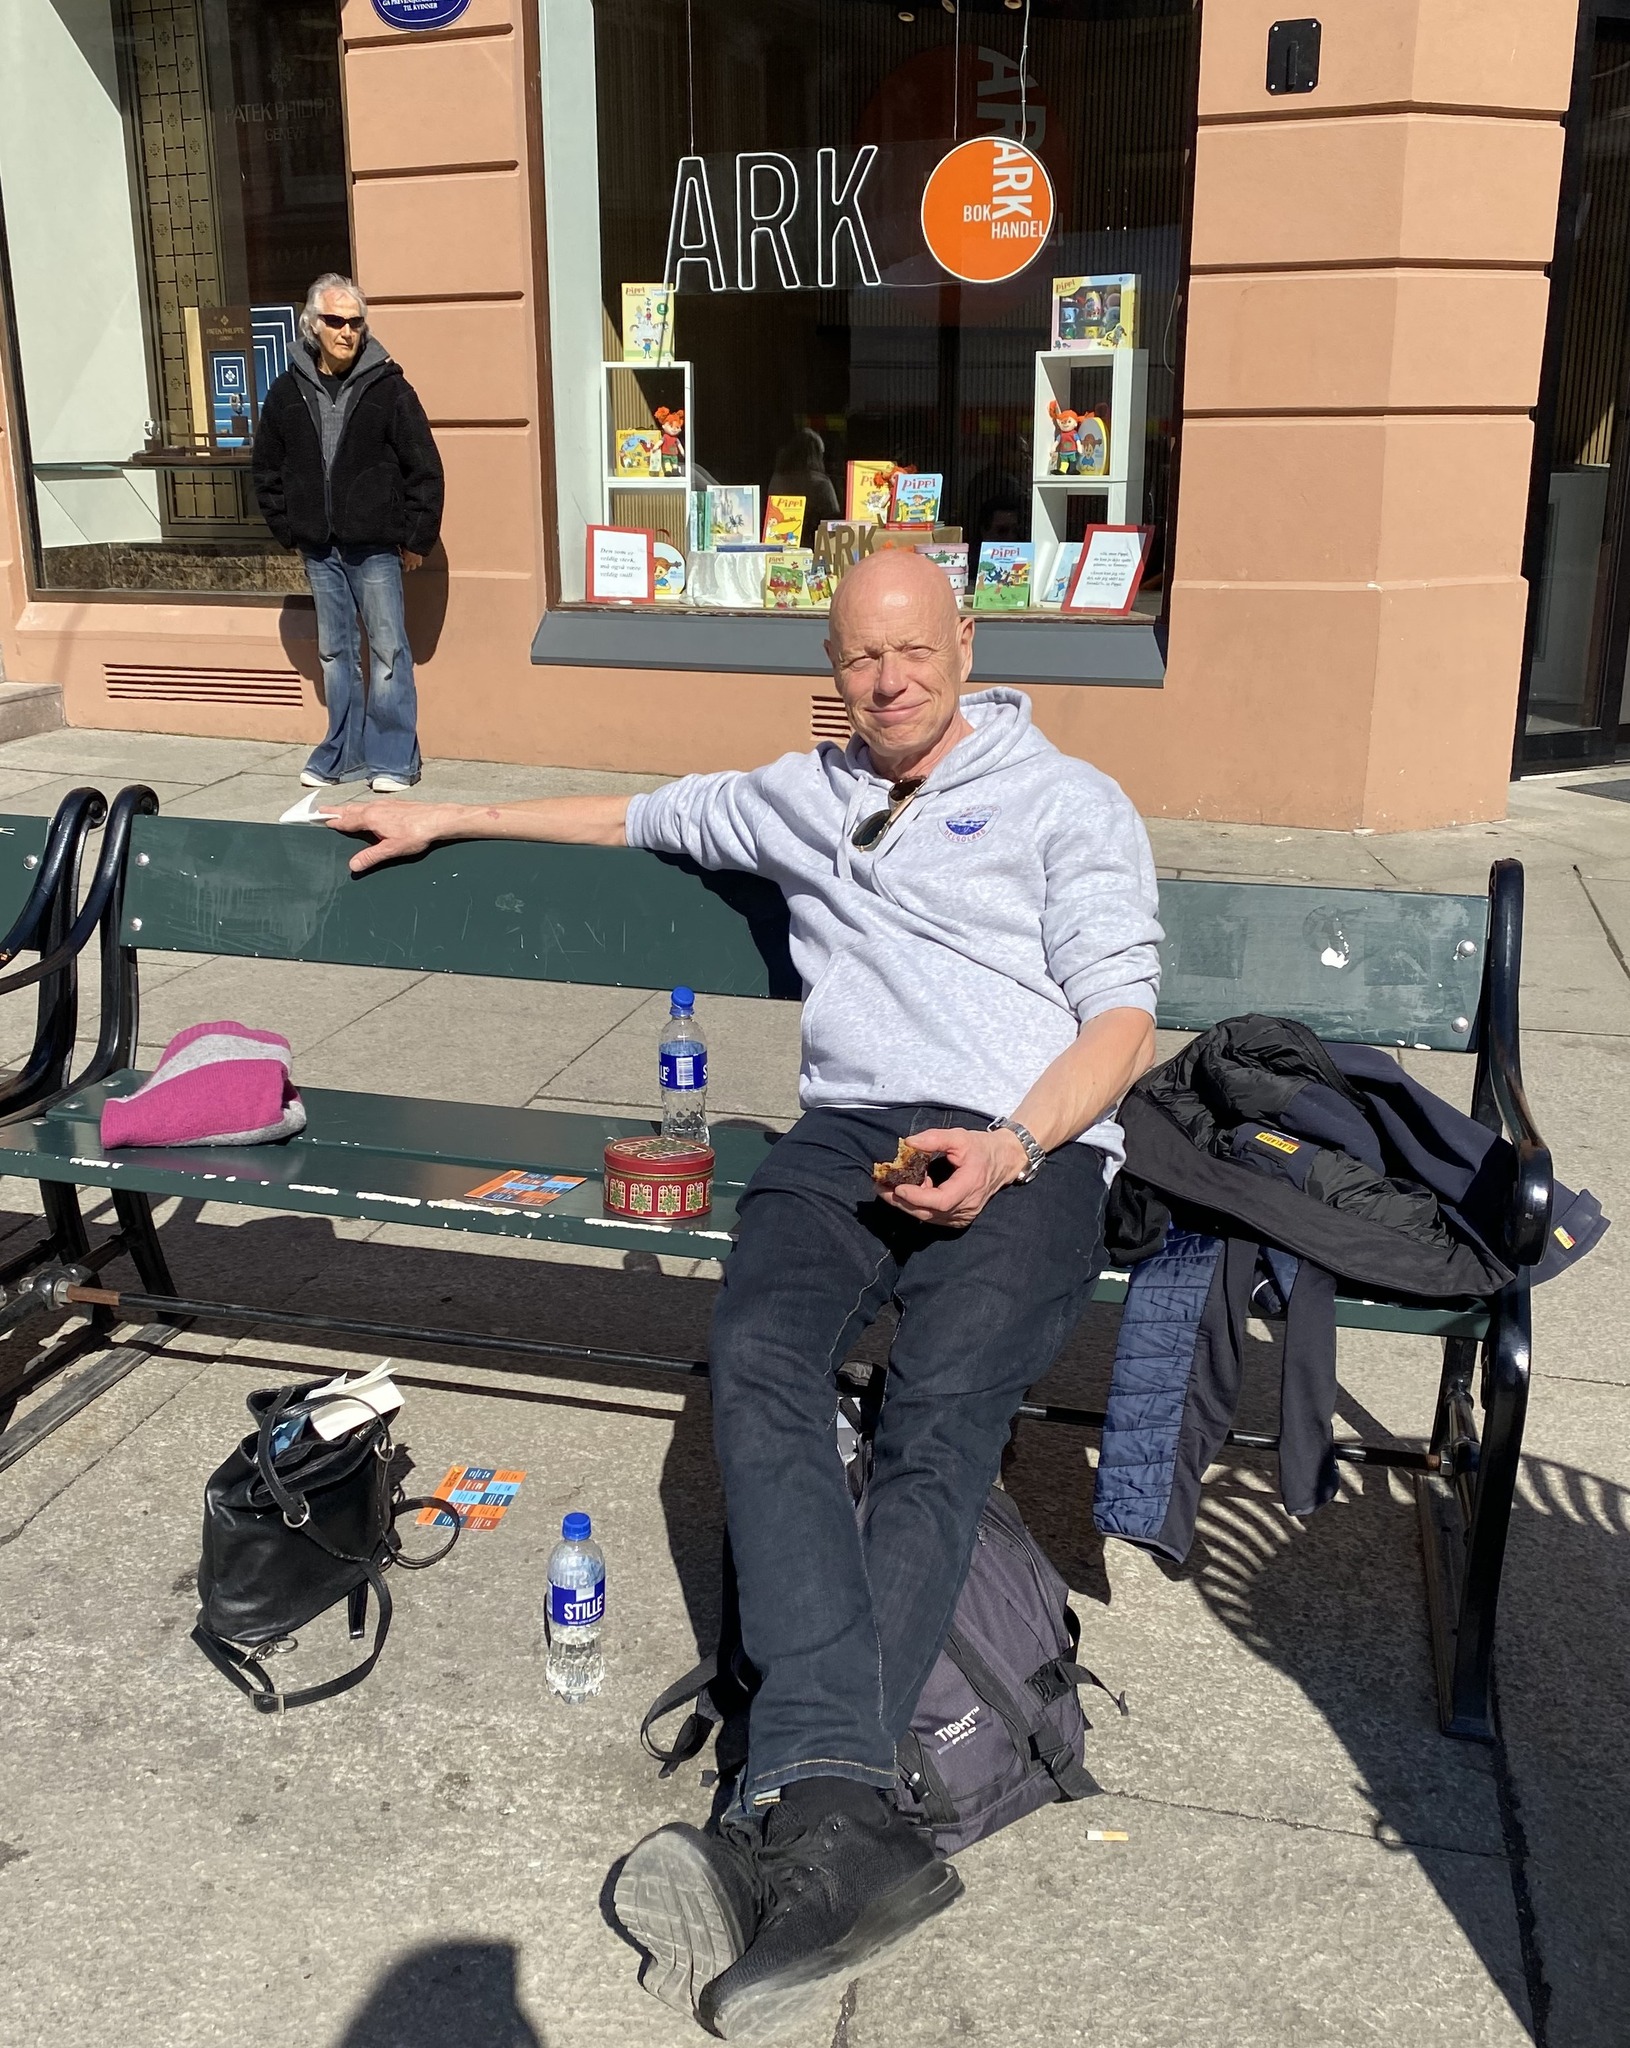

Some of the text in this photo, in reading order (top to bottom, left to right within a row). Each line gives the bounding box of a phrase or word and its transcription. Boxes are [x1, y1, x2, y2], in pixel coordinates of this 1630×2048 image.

[224, 98, 341, 124] PATEK PHILIPP
[992, 139, 1034, 220] ARK
[664, 145, 882, 292] ARK
[963, 204, 992, 222] BOK
[992, 220, 1046, 240] HANDEL
[810, 520, 878, 576] ARK
[564, 1596, 603, 1620] STILLE
[952, 1726, 976, 1746] PRO
